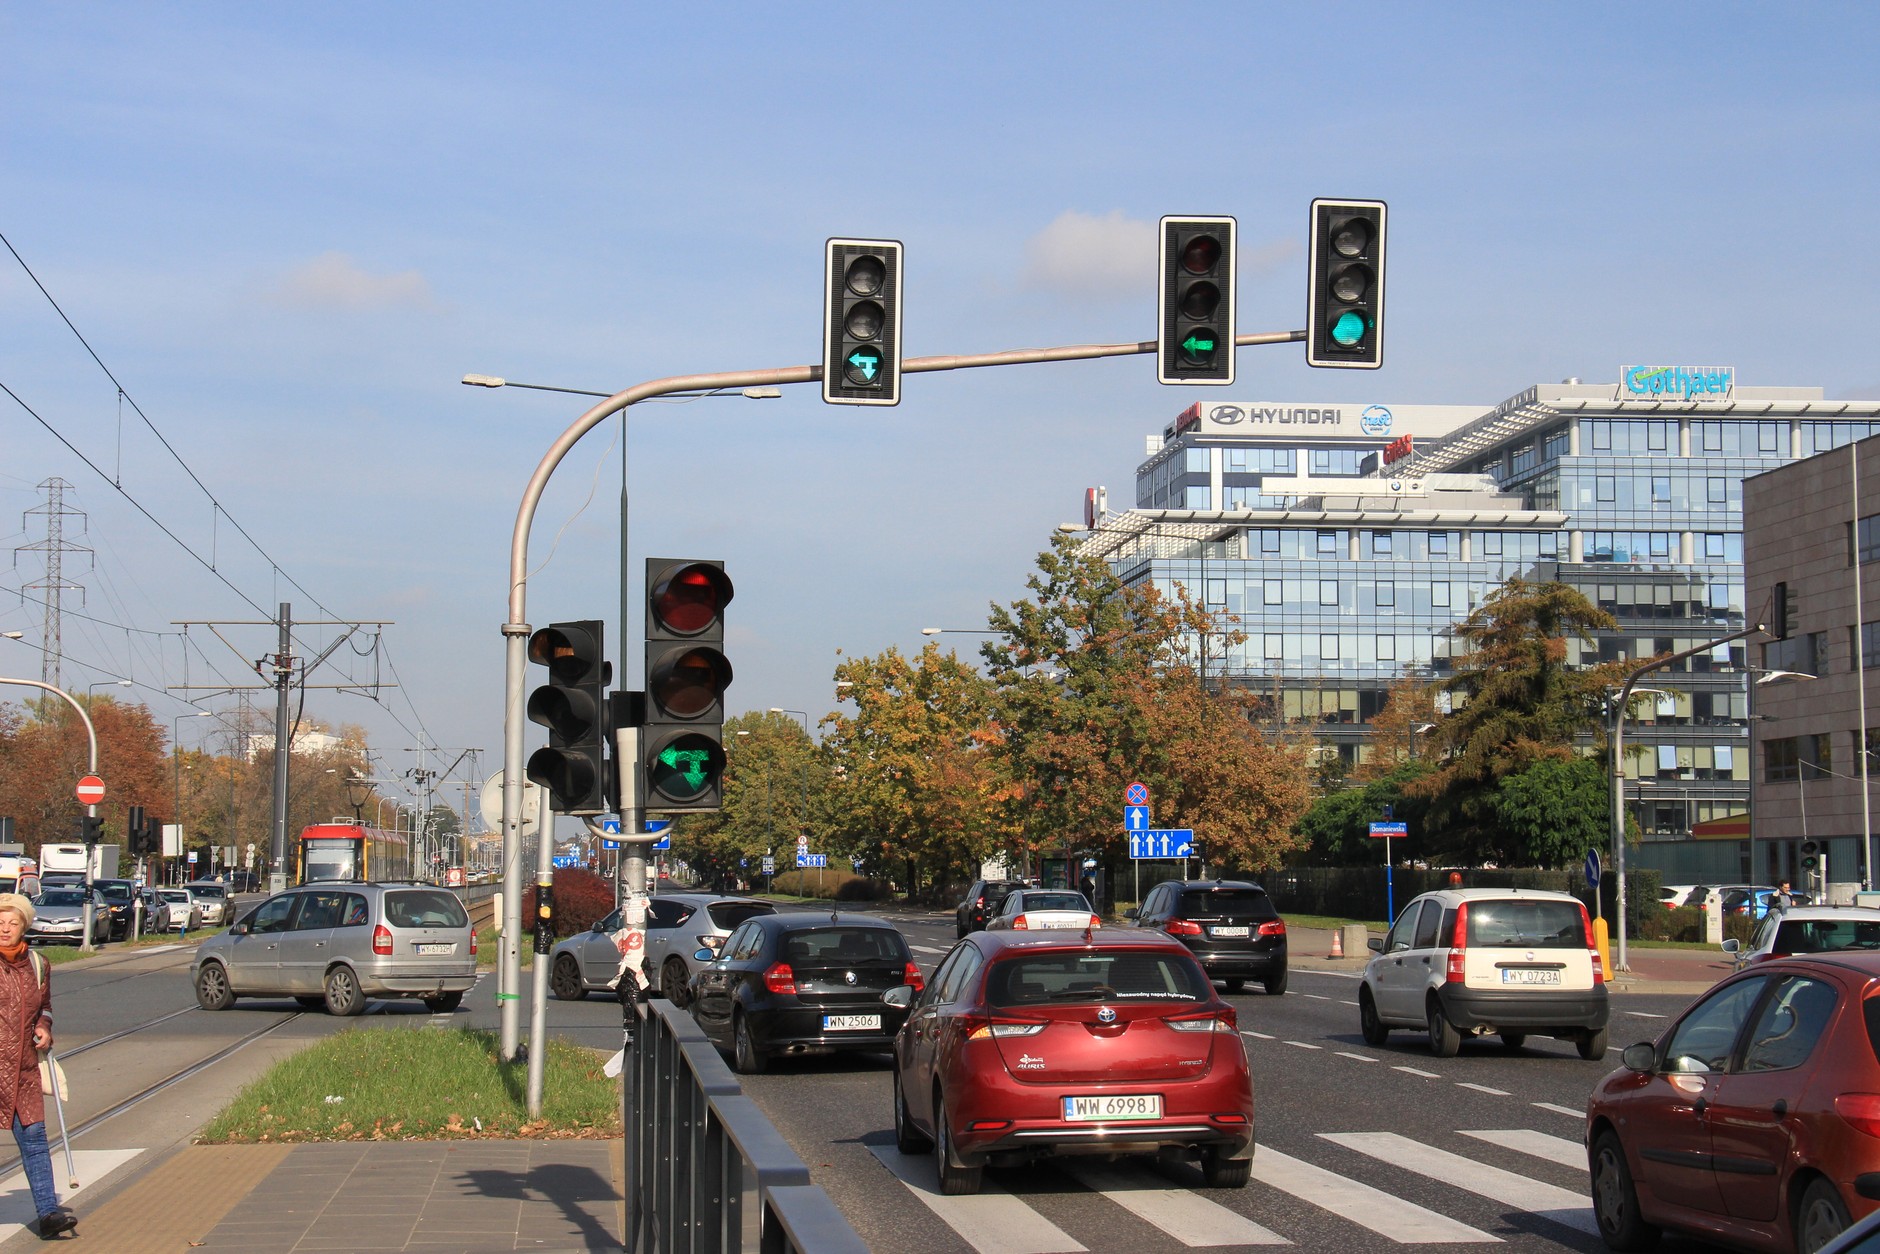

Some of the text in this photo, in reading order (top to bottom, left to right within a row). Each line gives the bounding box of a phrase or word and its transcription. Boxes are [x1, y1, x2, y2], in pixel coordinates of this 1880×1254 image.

[1626, 365, 1730, 400] Gothaer
[1251, 408, 1341, 425] HYUNDAI
[1371, 825, 1405, 833] Domaniewska
[1509, 971, 1524, 981] WY
[1528, 972, 1559, 982] 0723A
[830, 1015, 879, 1027] WN 2506J
[1076, 1096, 1156, 1115] WW 6998J
